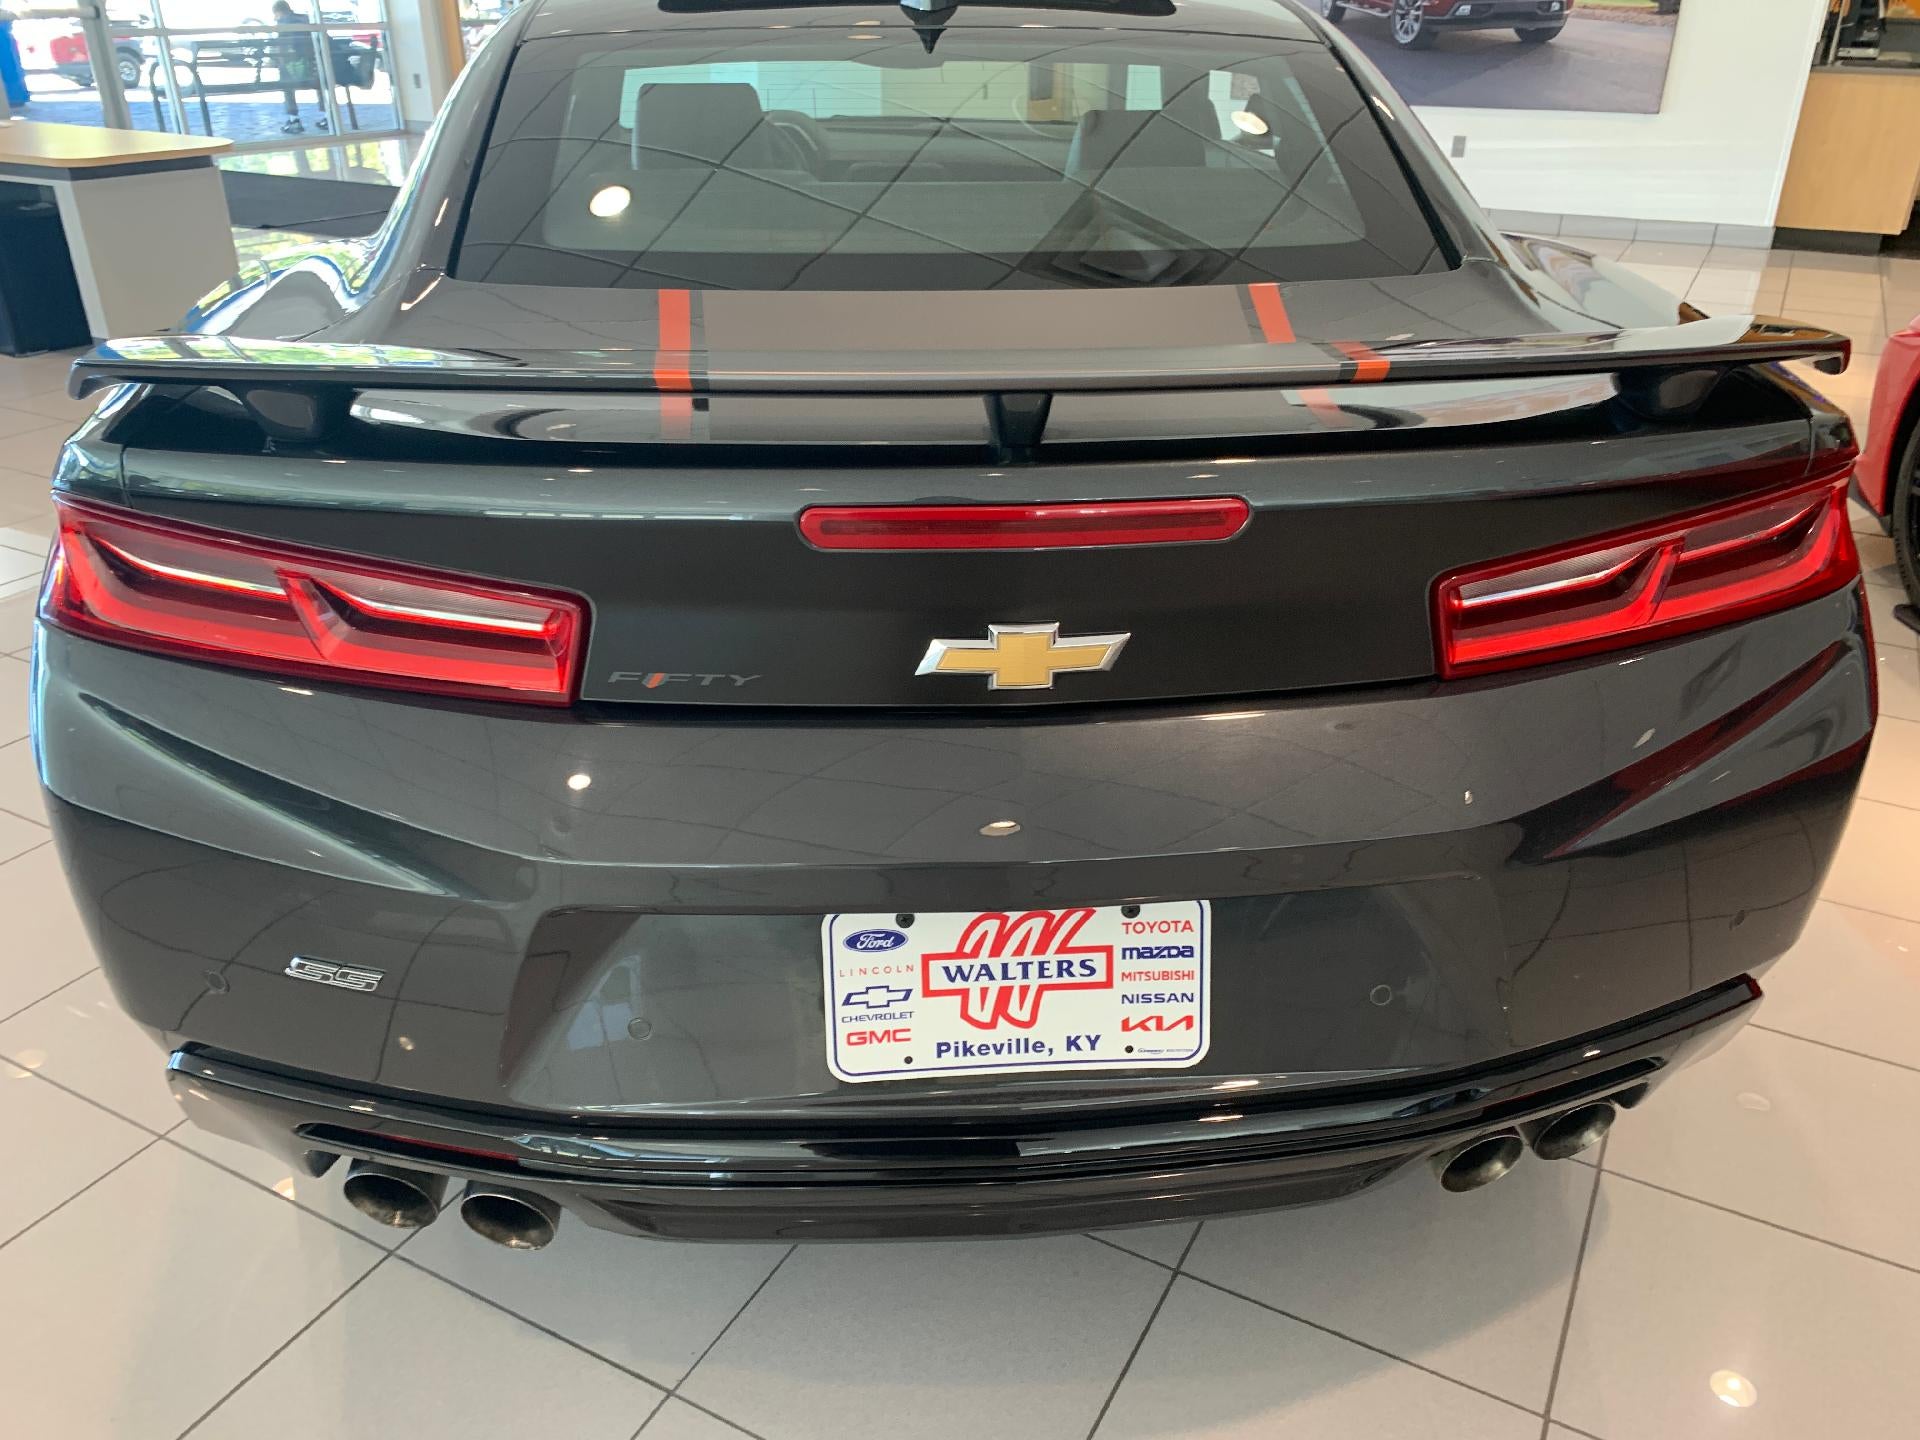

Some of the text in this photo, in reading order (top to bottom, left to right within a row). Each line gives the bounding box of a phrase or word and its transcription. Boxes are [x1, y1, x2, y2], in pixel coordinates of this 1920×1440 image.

[607, 671, 763, 689] FIFTY
[1121, 919, 1194, 935] TOYOTA
[857, 932, 895, 951] Ford
[285, 956, 386, 992] SS
[839, 963, 915, 978] LINCOLN
[941, 958, 1098, 984] WALTERS
[1121, 969, 1195, 982] MITSUBISHI
[1121, 992, 1195, 1005] NISSAN
[841, 1010, 914, 1024] CHEVROLET
[1121, 1015, 1194, 1032] KIA
[846, 1028, 912, 1047] GMC
[936, 1034, 1102, 1060] Pikeville, KY
